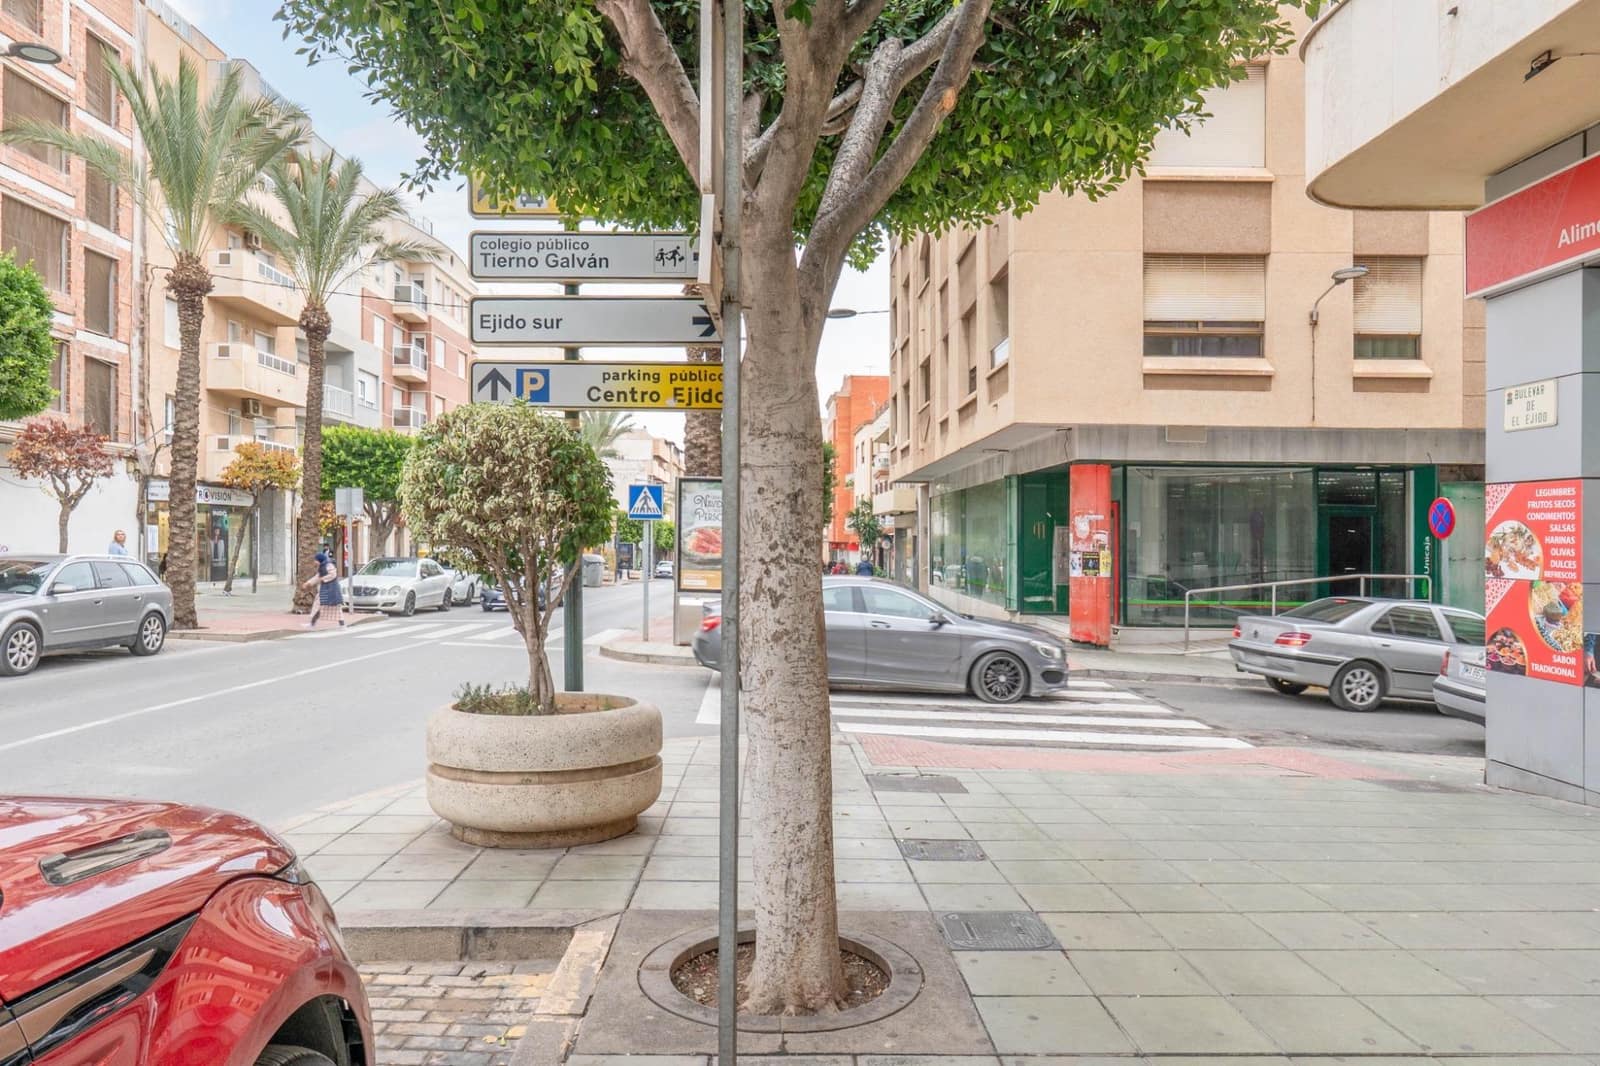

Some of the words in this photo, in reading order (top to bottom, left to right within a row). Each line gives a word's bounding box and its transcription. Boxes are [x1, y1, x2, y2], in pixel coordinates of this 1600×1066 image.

[480, 238, 532, 253] colegio
[537, 238, 590, 253] público
[480, 252, 539, 268] Tierno
[545, 252, 609, 269] Galván
[480, 314, 526, 333] Ejido
[532, 317, 563, 330] sur
[602, 369, 661, 384] parking
[523, 371, 545, 401] P
[1514, 384, 1545, 400] BULEVAR
[587, 385, 661, 403] Centro
[1526, 400, 1536, 412] DE
[1511, 416, 1520, 427] EL
[1525, 412, 1548, 425] EJIDO
[1535, 487, 1576, 497] LEGUMBRES
[1527, 500, 1553, 509] FRUTOS
[1554, 499, 1576, 508] SECOS
[1526, 511, 1576, 520] CONDIMENTOS
[1550, 523, 1576, 532] SALSAS
[1544, 535, 1576, 544] HARINAS
[1550, 547, 1576, 557] OLIVAS
[1550, 559, 1577, 569] DULCES
[1543, 570, 1577, 579] REFRESCOS
[1552, 654, 1577, 666] SABOR
[1531, 662, 1577, 678] TRADICIONAL
